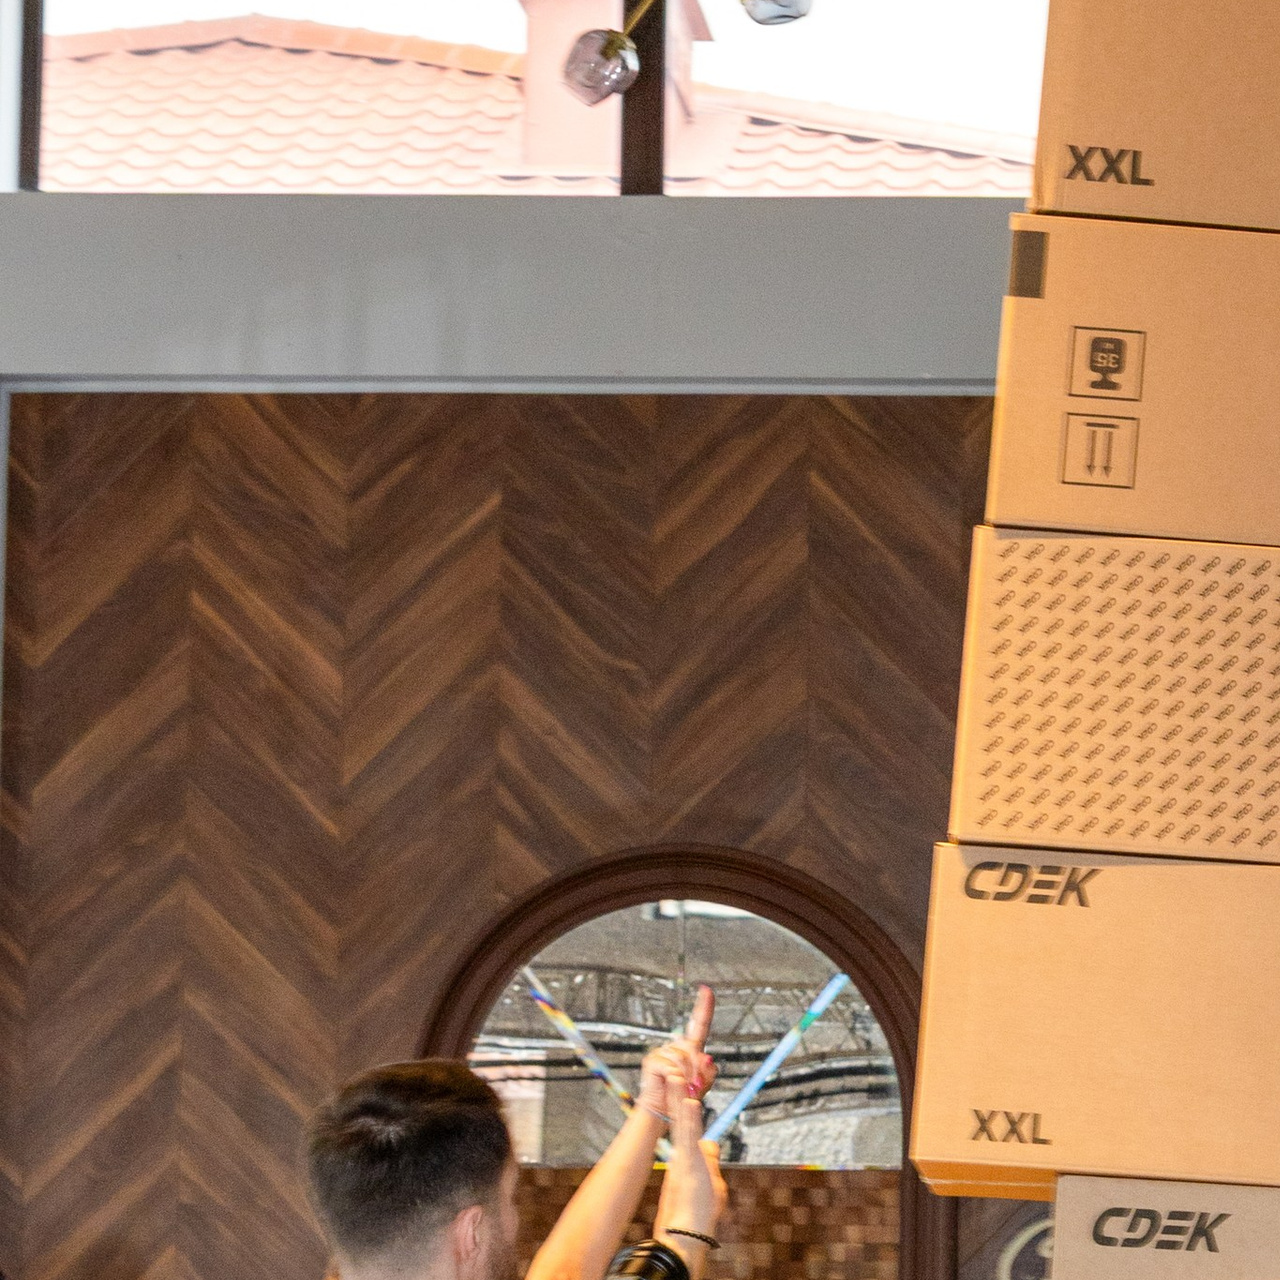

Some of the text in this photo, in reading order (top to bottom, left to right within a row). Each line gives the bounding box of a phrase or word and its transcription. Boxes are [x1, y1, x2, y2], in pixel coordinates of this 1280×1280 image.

[1065, 145, 1154, 186] XXL
[1095, 353, 1119, 368] 35
[963, 861, 1101, 907] CDEK
[972, 1109, 1051, 1145] XXL
[1092, 1207, 1230, 1252] CDEK
